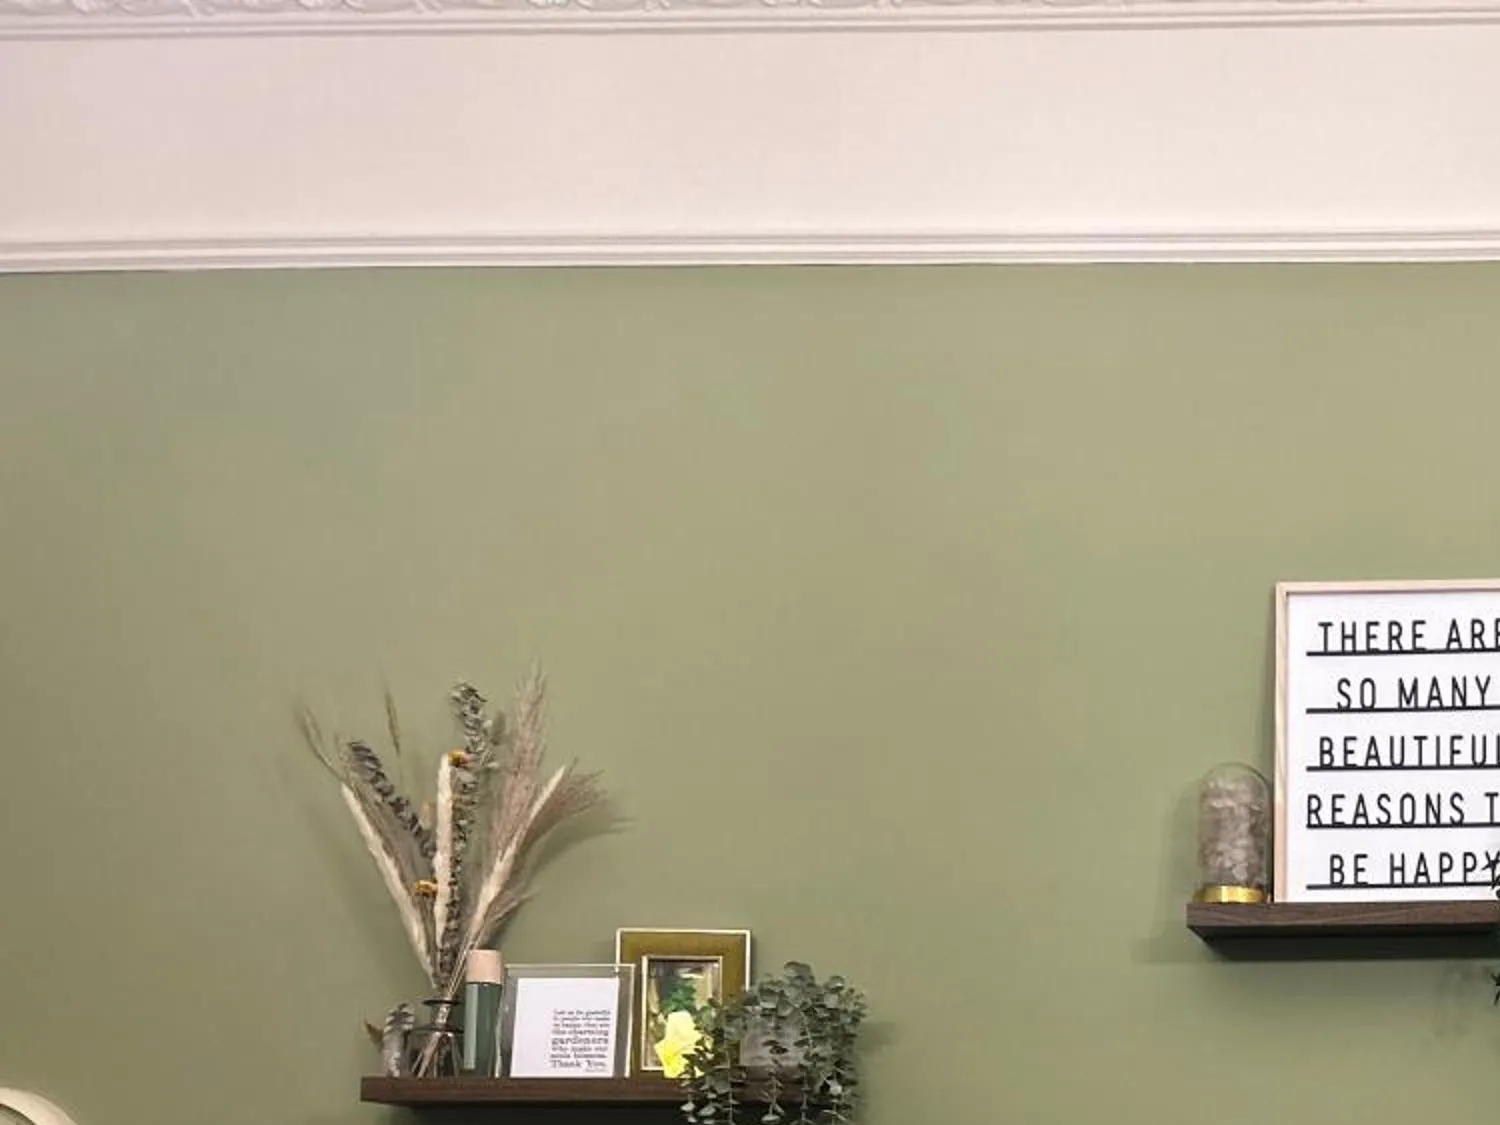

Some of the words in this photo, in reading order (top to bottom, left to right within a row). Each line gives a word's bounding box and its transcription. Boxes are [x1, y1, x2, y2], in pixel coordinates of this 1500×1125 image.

[1318, 621, 1427, 652] THERE
[1337, 677, 1377, 709] SO
[1398, 675, 1491, 708] MANY
[1307, 793, 1465, 826] REASONS
[1329, 853, 1369, 885] BE
[1389, 851, 1500, 885] HAPPY
